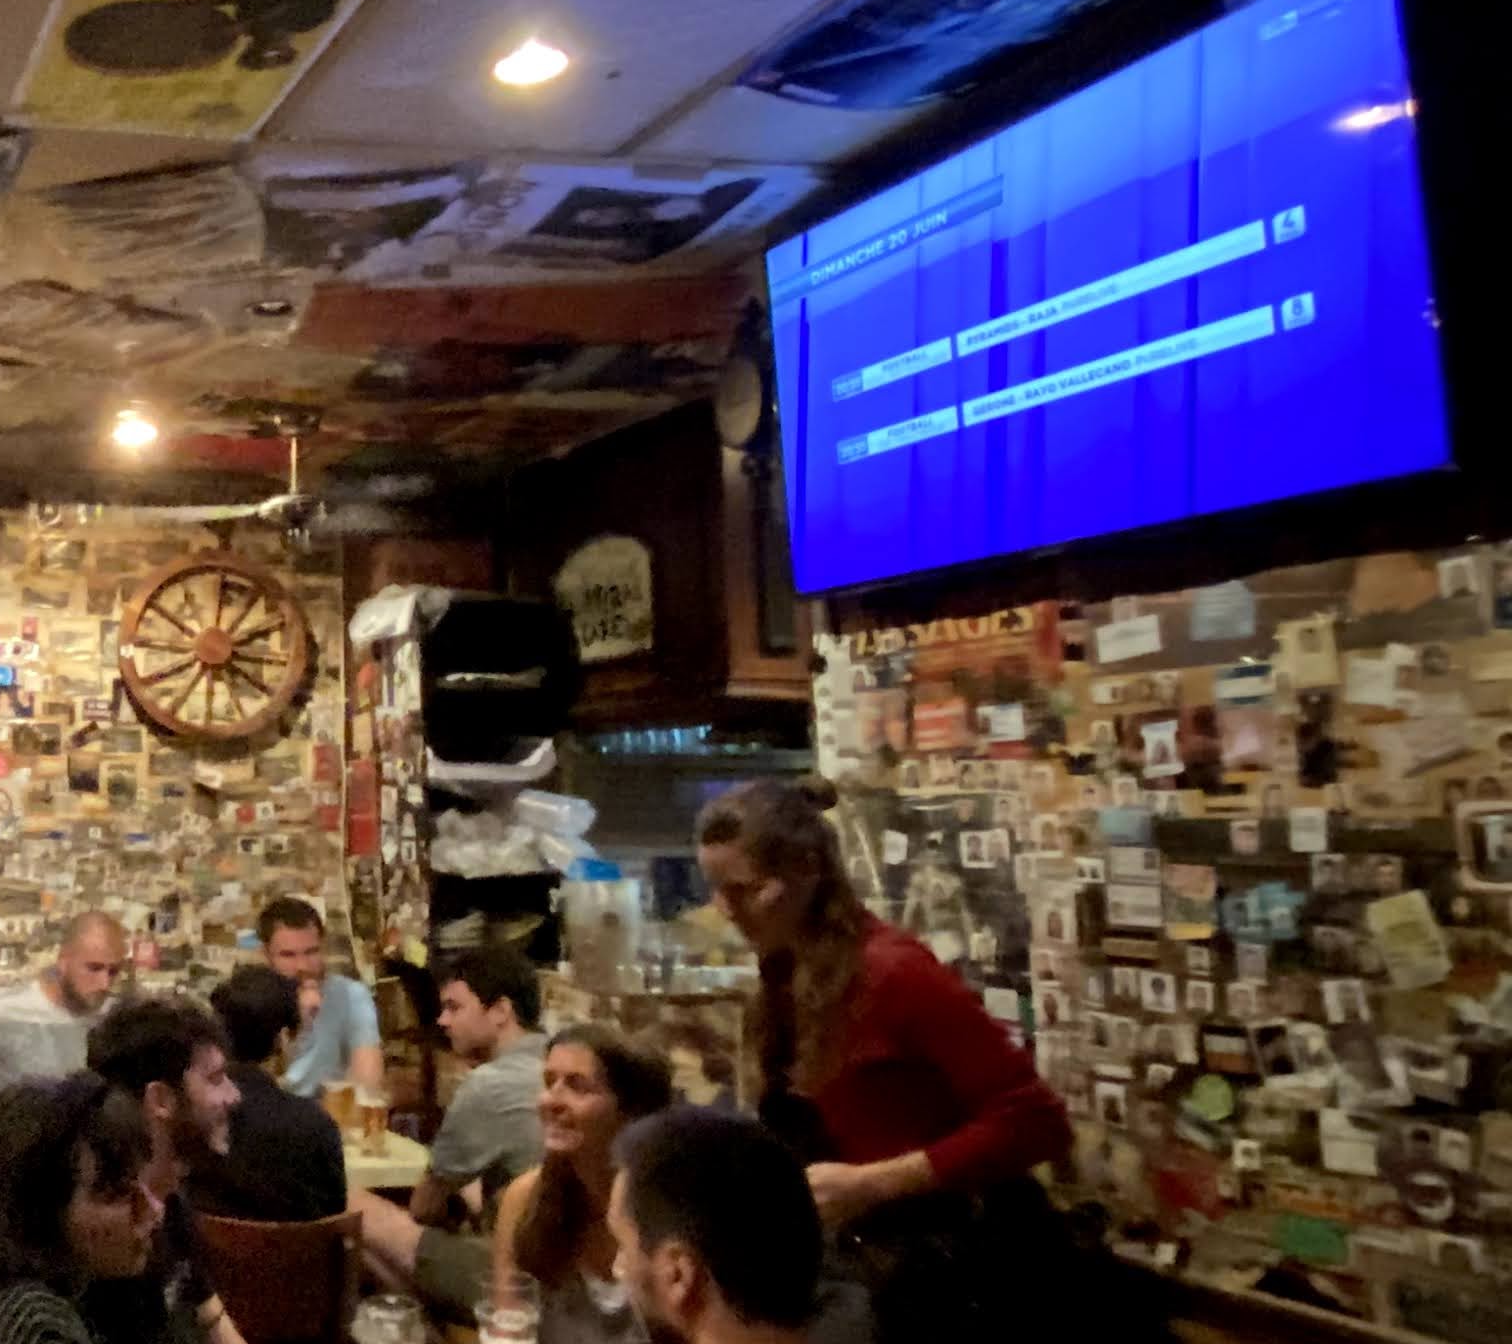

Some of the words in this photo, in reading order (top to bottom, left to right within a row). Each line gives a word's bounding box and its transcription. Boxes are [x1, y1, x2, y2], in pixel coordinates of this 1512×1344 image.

[810, 240, 885, 285] DIMANCHE
[888, 229, 908, 251] 20
[910, 210, 949, 239] JUIN
[1024, 384, 1058, 401] RAYO
[1059, 359, 1133, 390] VALLECANO
